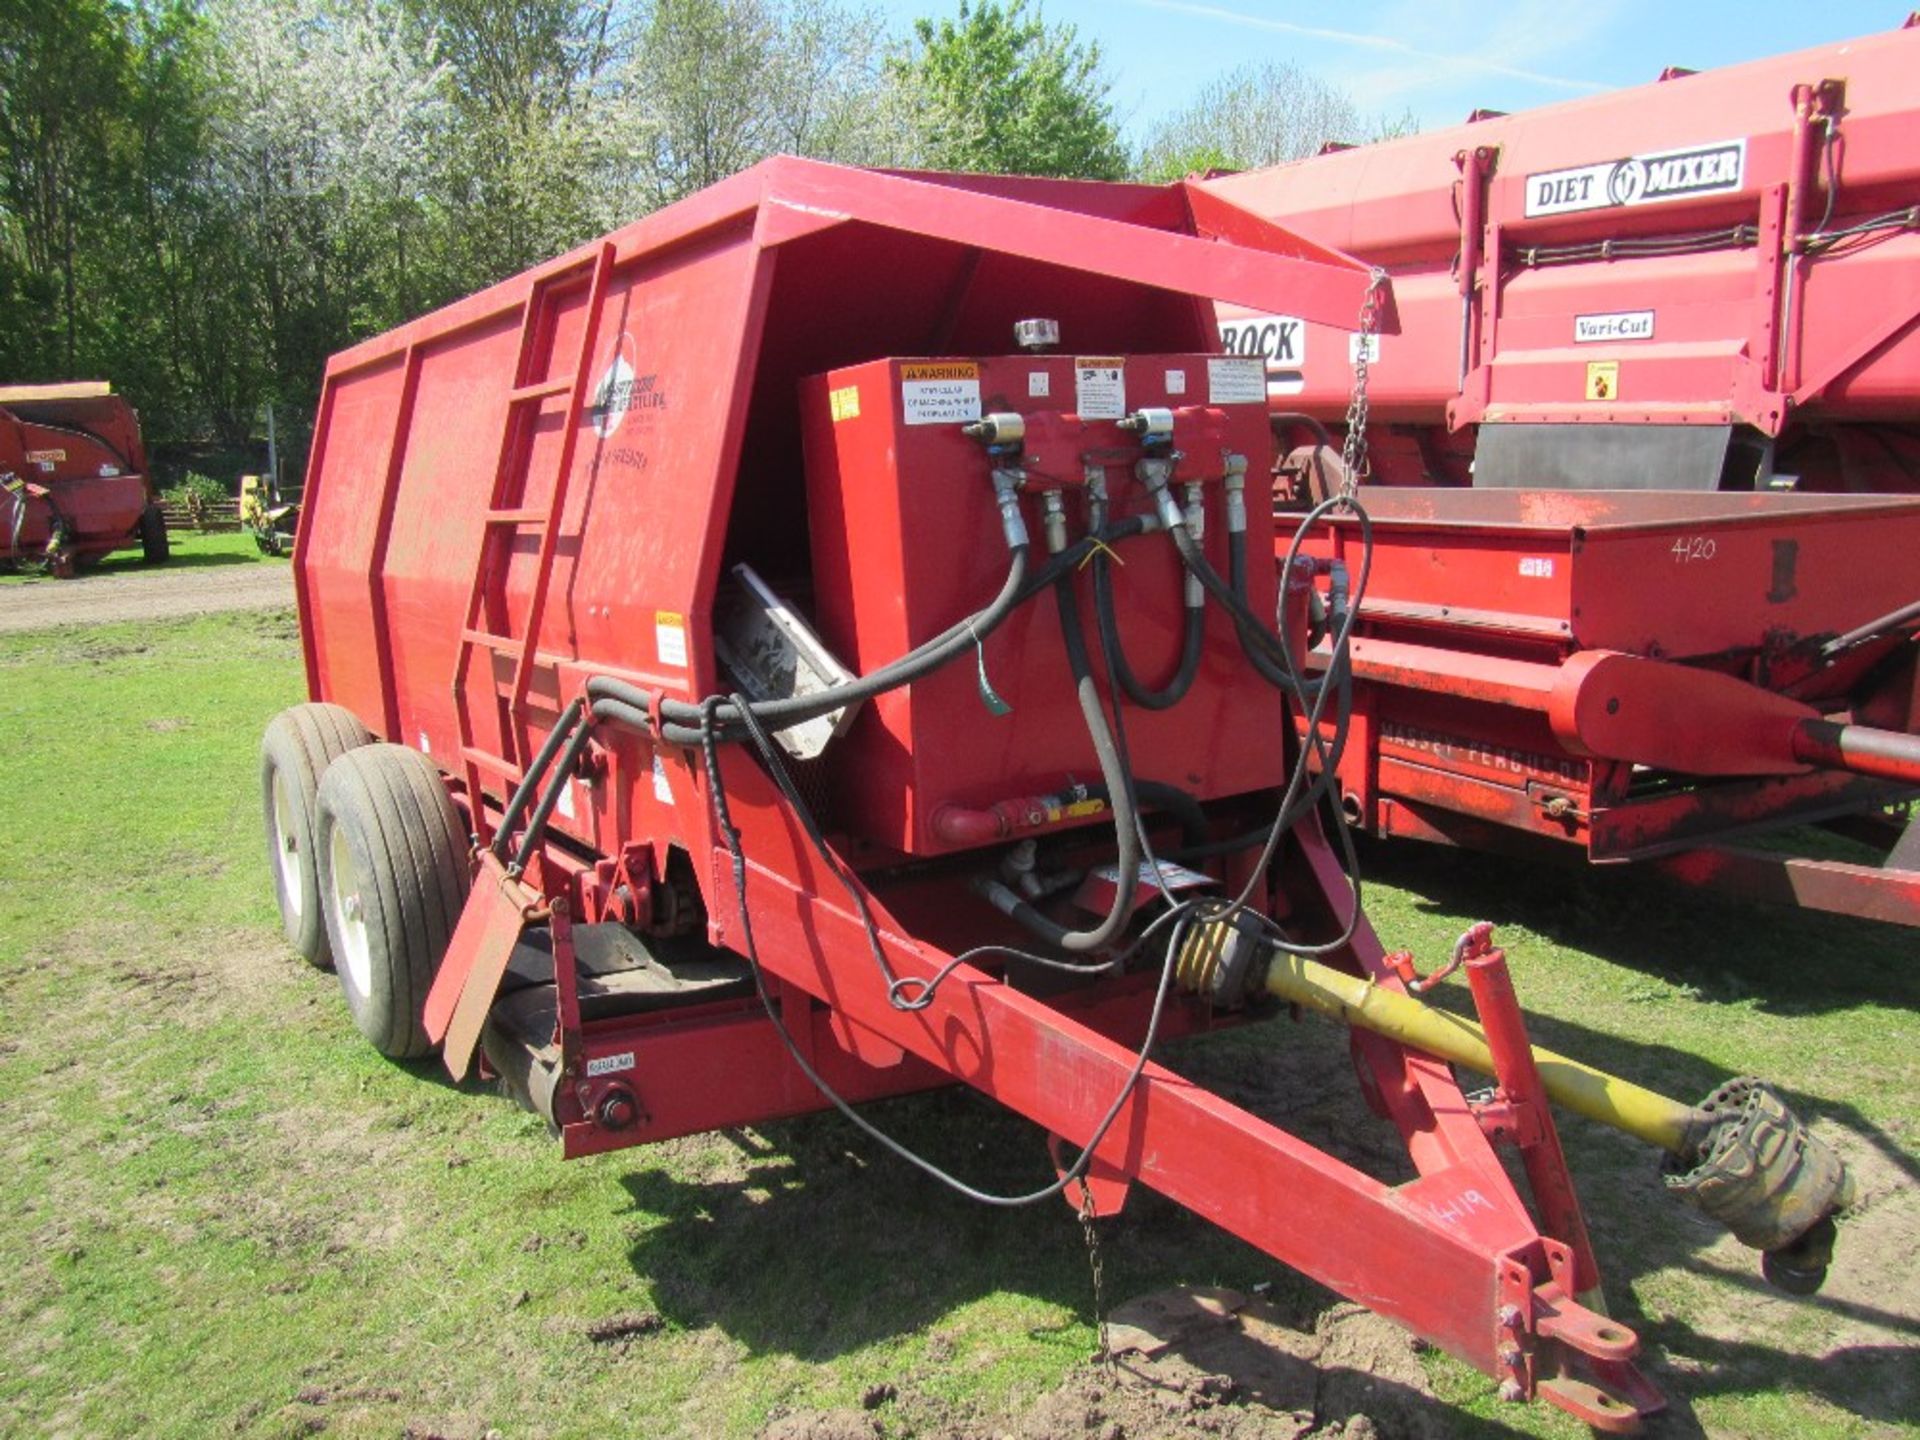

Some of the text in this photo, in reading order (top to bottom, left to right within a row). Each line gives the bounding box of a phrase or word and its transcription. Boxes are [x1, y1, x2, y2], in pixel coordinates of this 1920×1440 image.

[1537, 151, 1738, 206] DIET MIXER
[1579, 318, 1649, 336] Vari-Cut
[919, 367, 975, 379] WARNING
